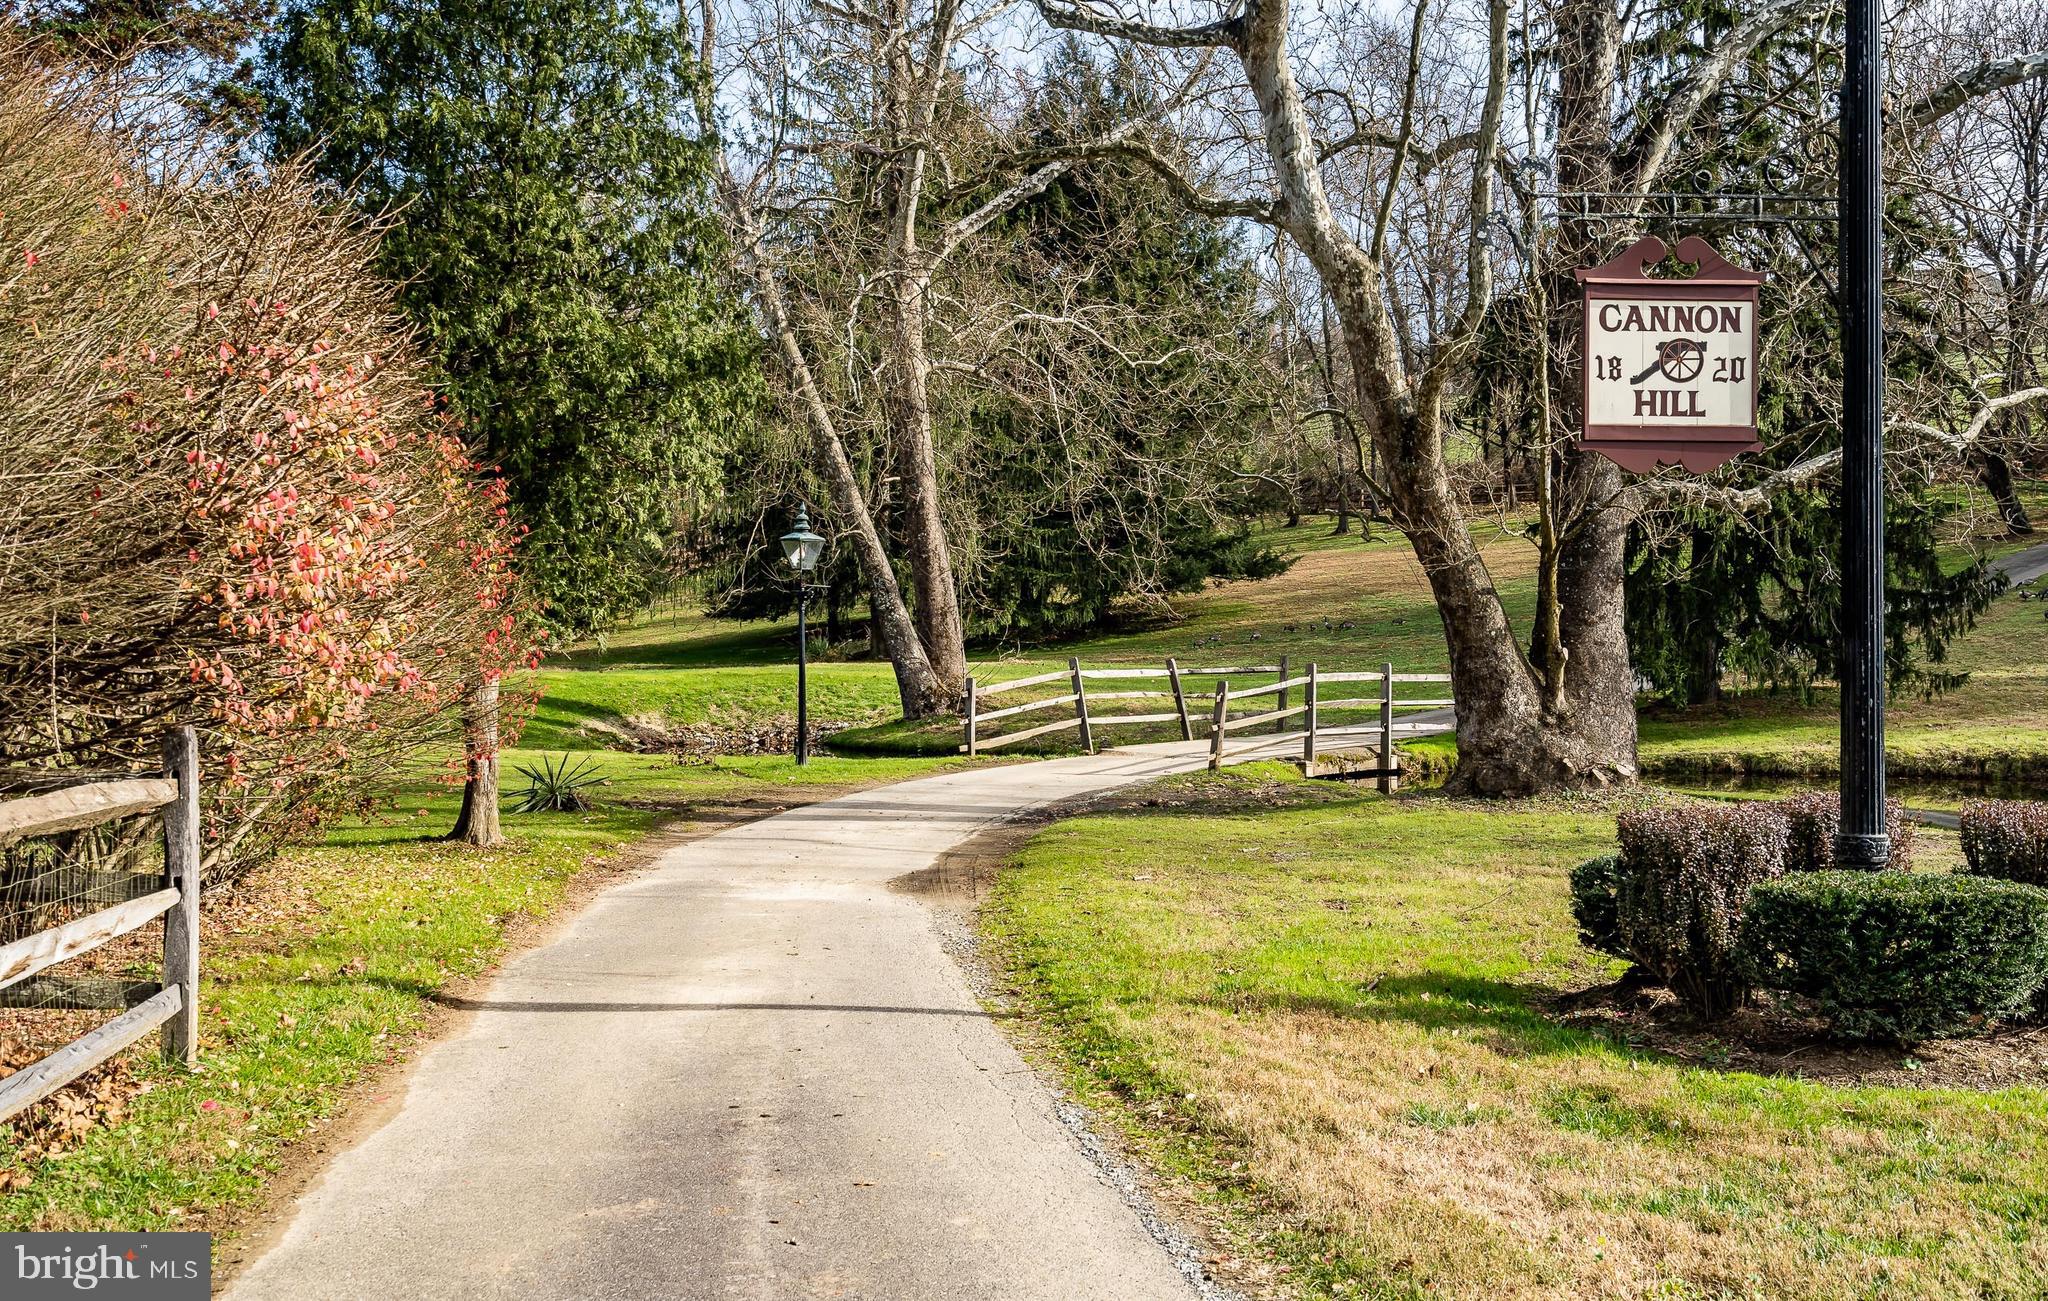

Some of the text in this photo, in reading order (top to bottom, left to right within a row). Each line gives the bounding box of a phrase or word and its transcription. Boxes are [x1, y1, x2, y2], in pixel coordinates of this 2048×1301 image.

[1599, 304, 1743, 333] CANNON
[1595, 355, 1746, 384] 18 20
[1633, 389, 1706, 417] HILL
